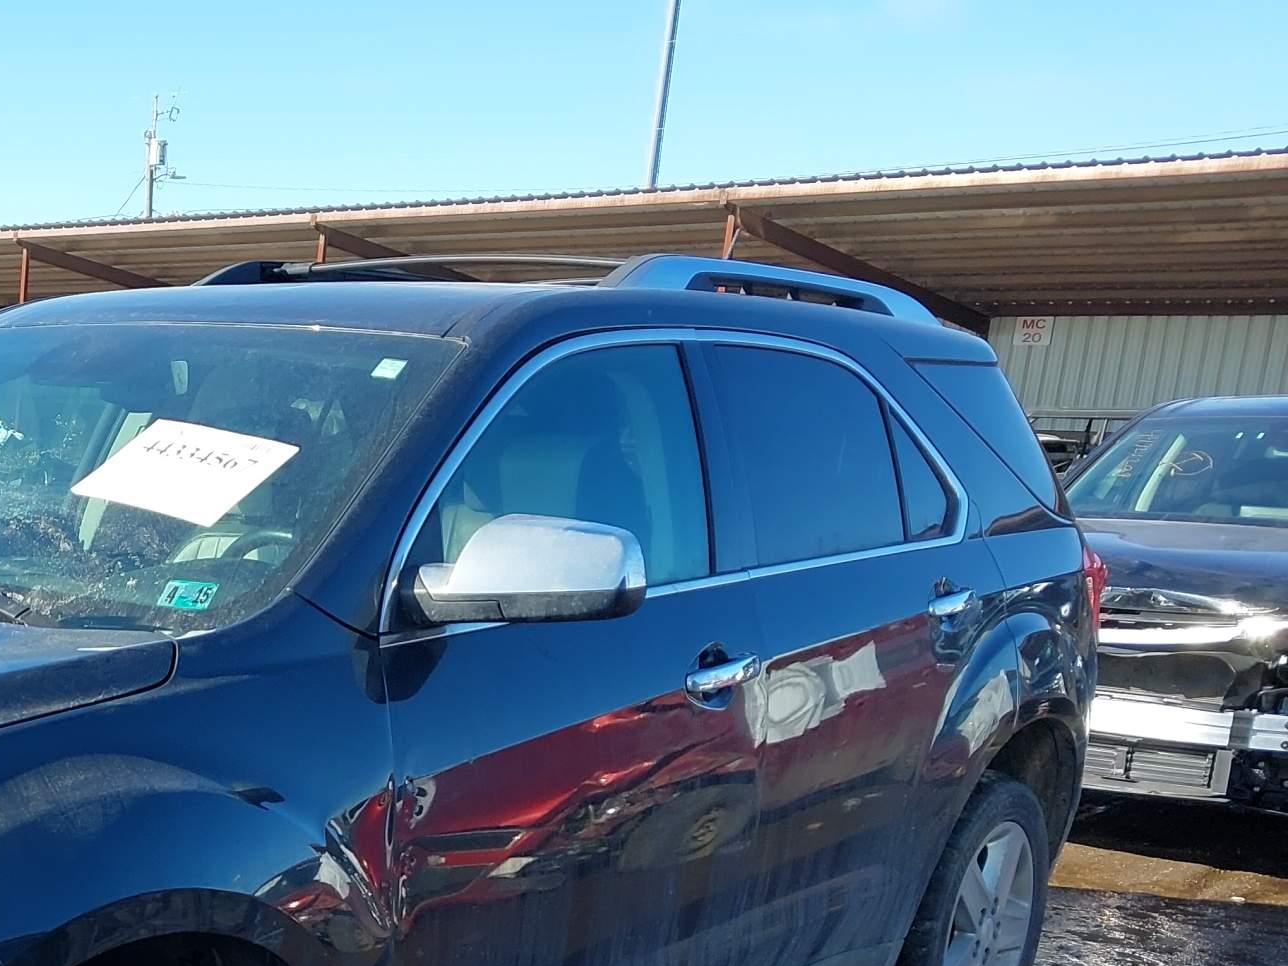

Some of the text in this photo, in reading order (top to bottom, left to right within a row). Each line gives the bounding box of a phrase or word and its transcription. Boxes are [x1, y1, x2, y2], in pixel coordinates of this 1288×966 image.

[1022, 319, 1047, 329] MC
[1022, 332, 1042, 343] 20
[165, 585, 214, 604] 4 15
